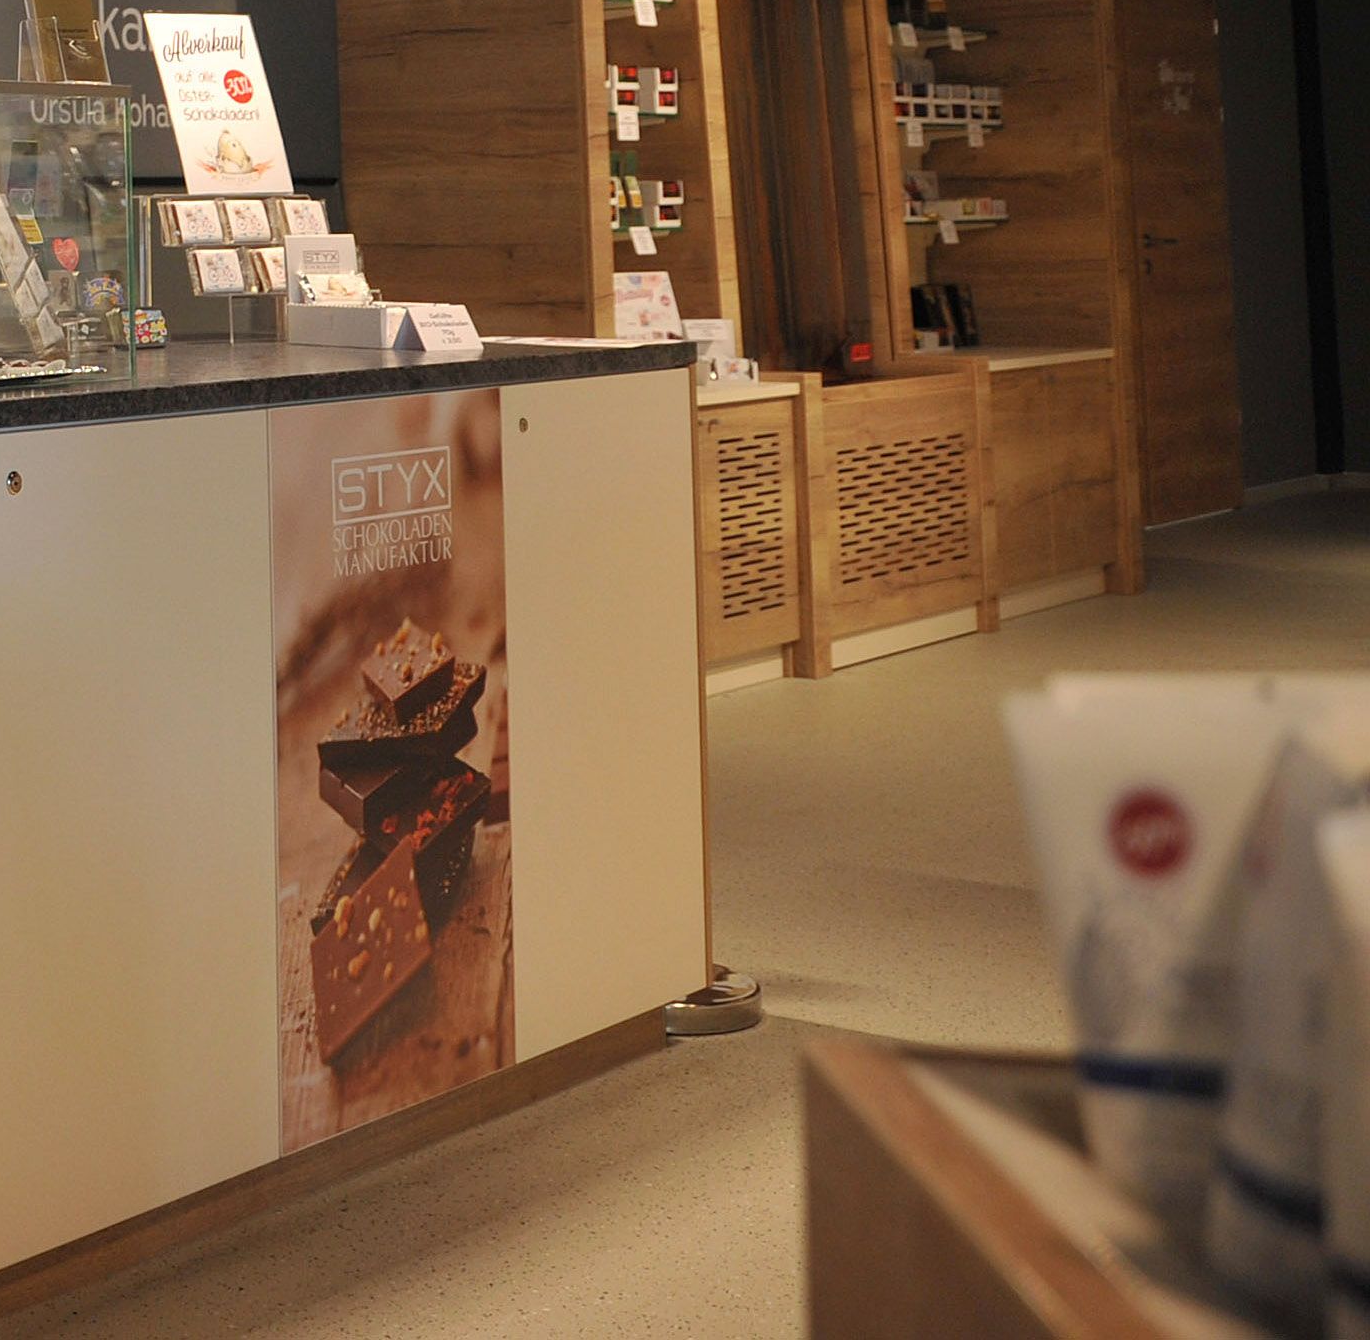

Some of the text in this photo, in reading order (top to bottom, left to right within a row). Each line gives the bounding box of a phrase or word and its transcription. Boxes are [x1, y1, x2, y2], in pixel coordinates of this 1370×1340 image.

[30, 94, 107, 126] Ursula
[304, 251, 339, 262] STYX
[337, 457, 446, 513] STYX
[332, 511, 453, 553] SCHOKOLADEN
[333, 536, 453, 579] MANUFAKTUR
